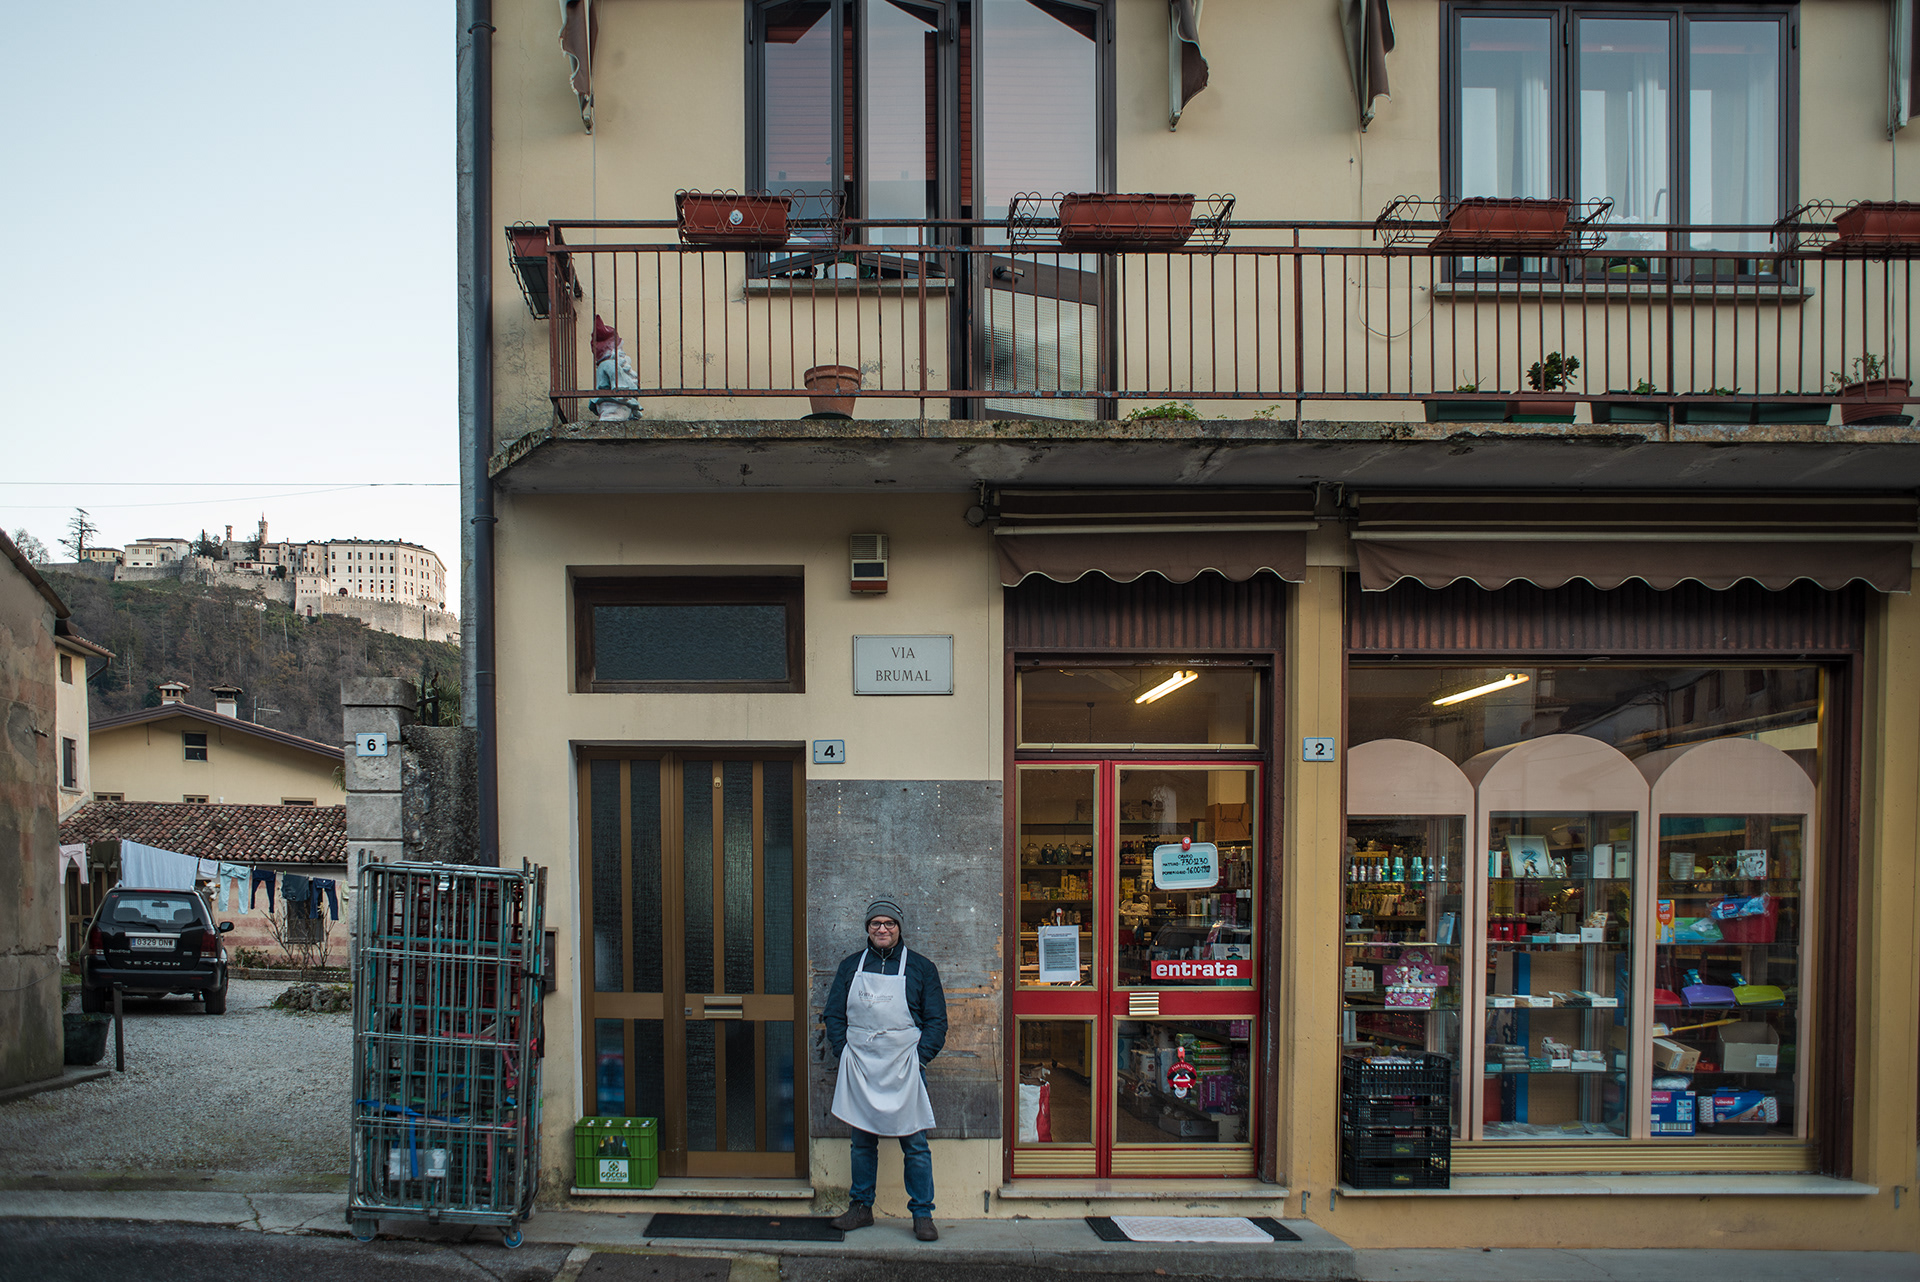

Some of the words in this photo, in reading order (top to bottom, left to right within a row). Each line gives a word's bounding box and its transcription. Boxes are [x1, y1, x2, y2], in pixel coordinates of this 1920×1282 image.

[891, 646, 916, 659] VIA
[875, 669, 932, 682] BRUMAL
[367, 738, 376, 752] 6
[824, 745, 835, 758] 4
[1315, 742, 1325, 756] 2
[1156, 962, 1238, 977] entrata
